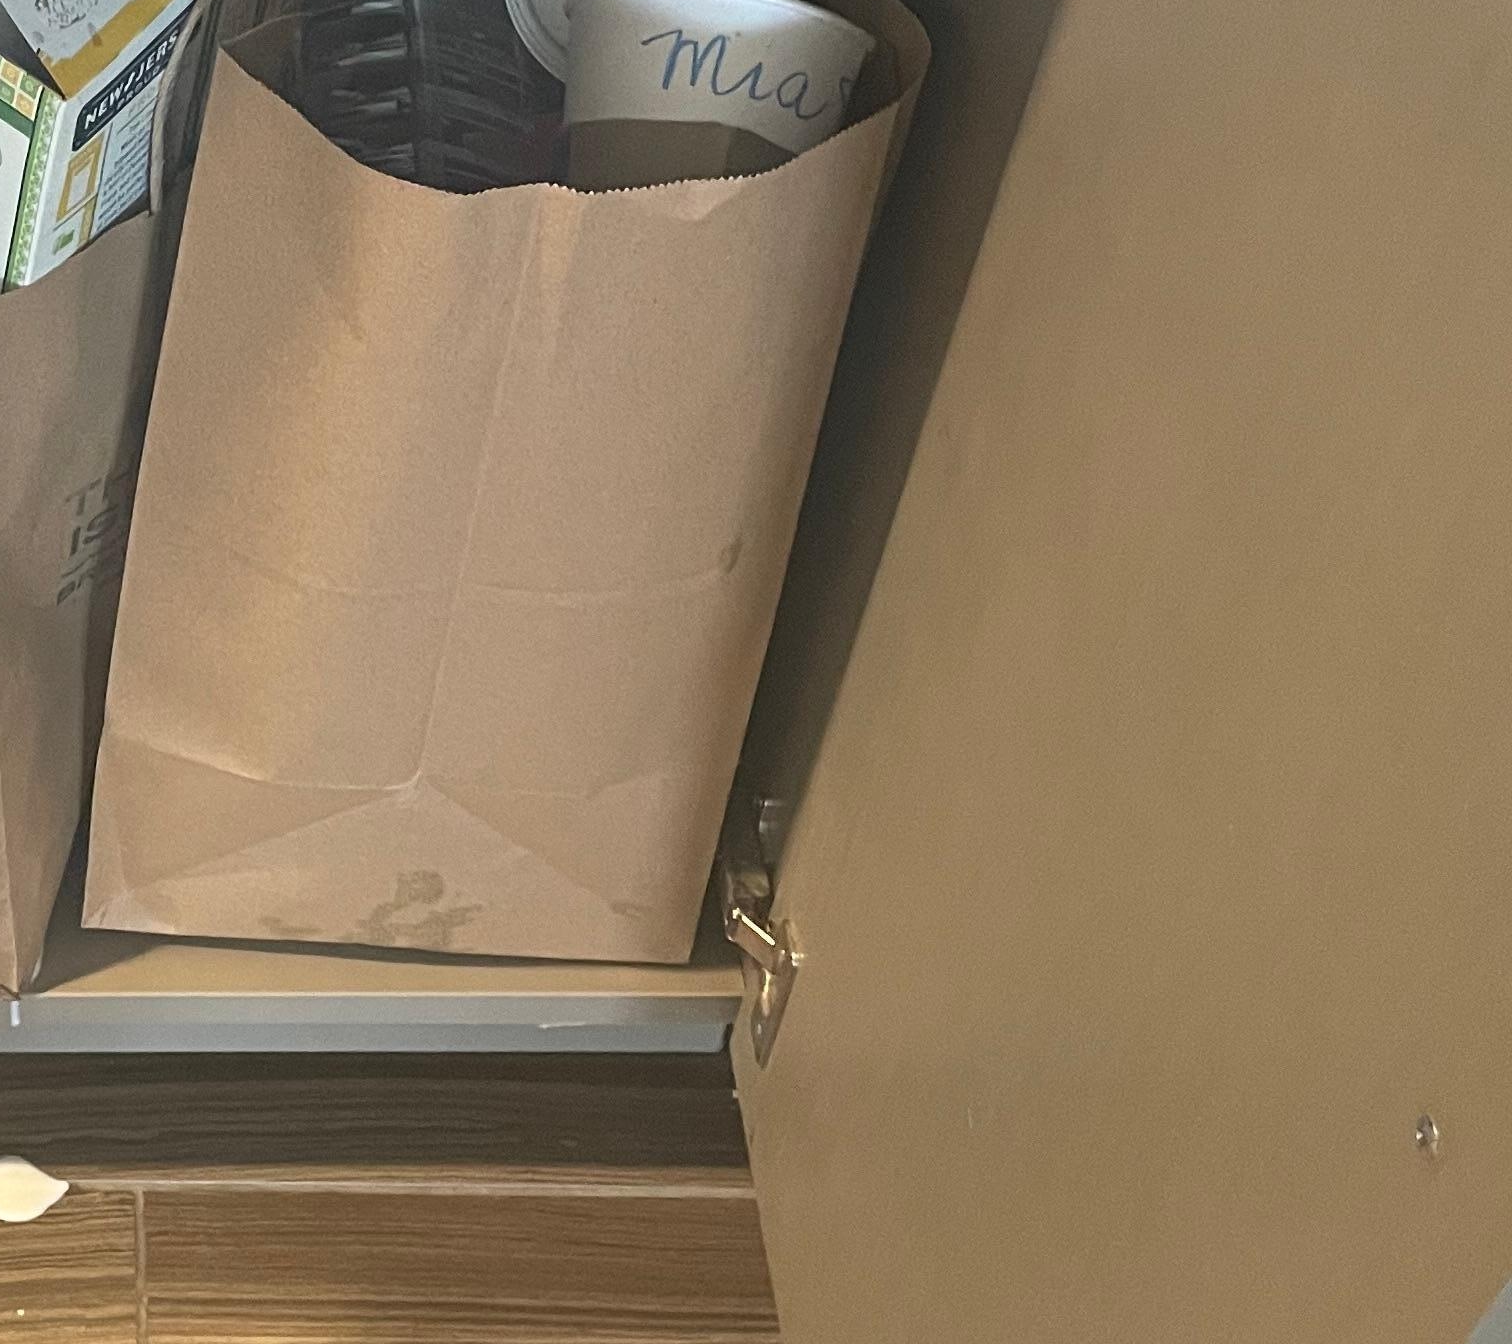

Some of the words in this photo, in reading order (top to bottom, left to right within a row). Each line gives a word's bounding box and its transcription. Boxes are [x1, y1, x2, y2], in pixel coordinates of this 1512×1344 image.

[85, 82, 125, 130] NEW
[135, 29, 179, 82] JERS
[641, 29, 829, 120] Mia
